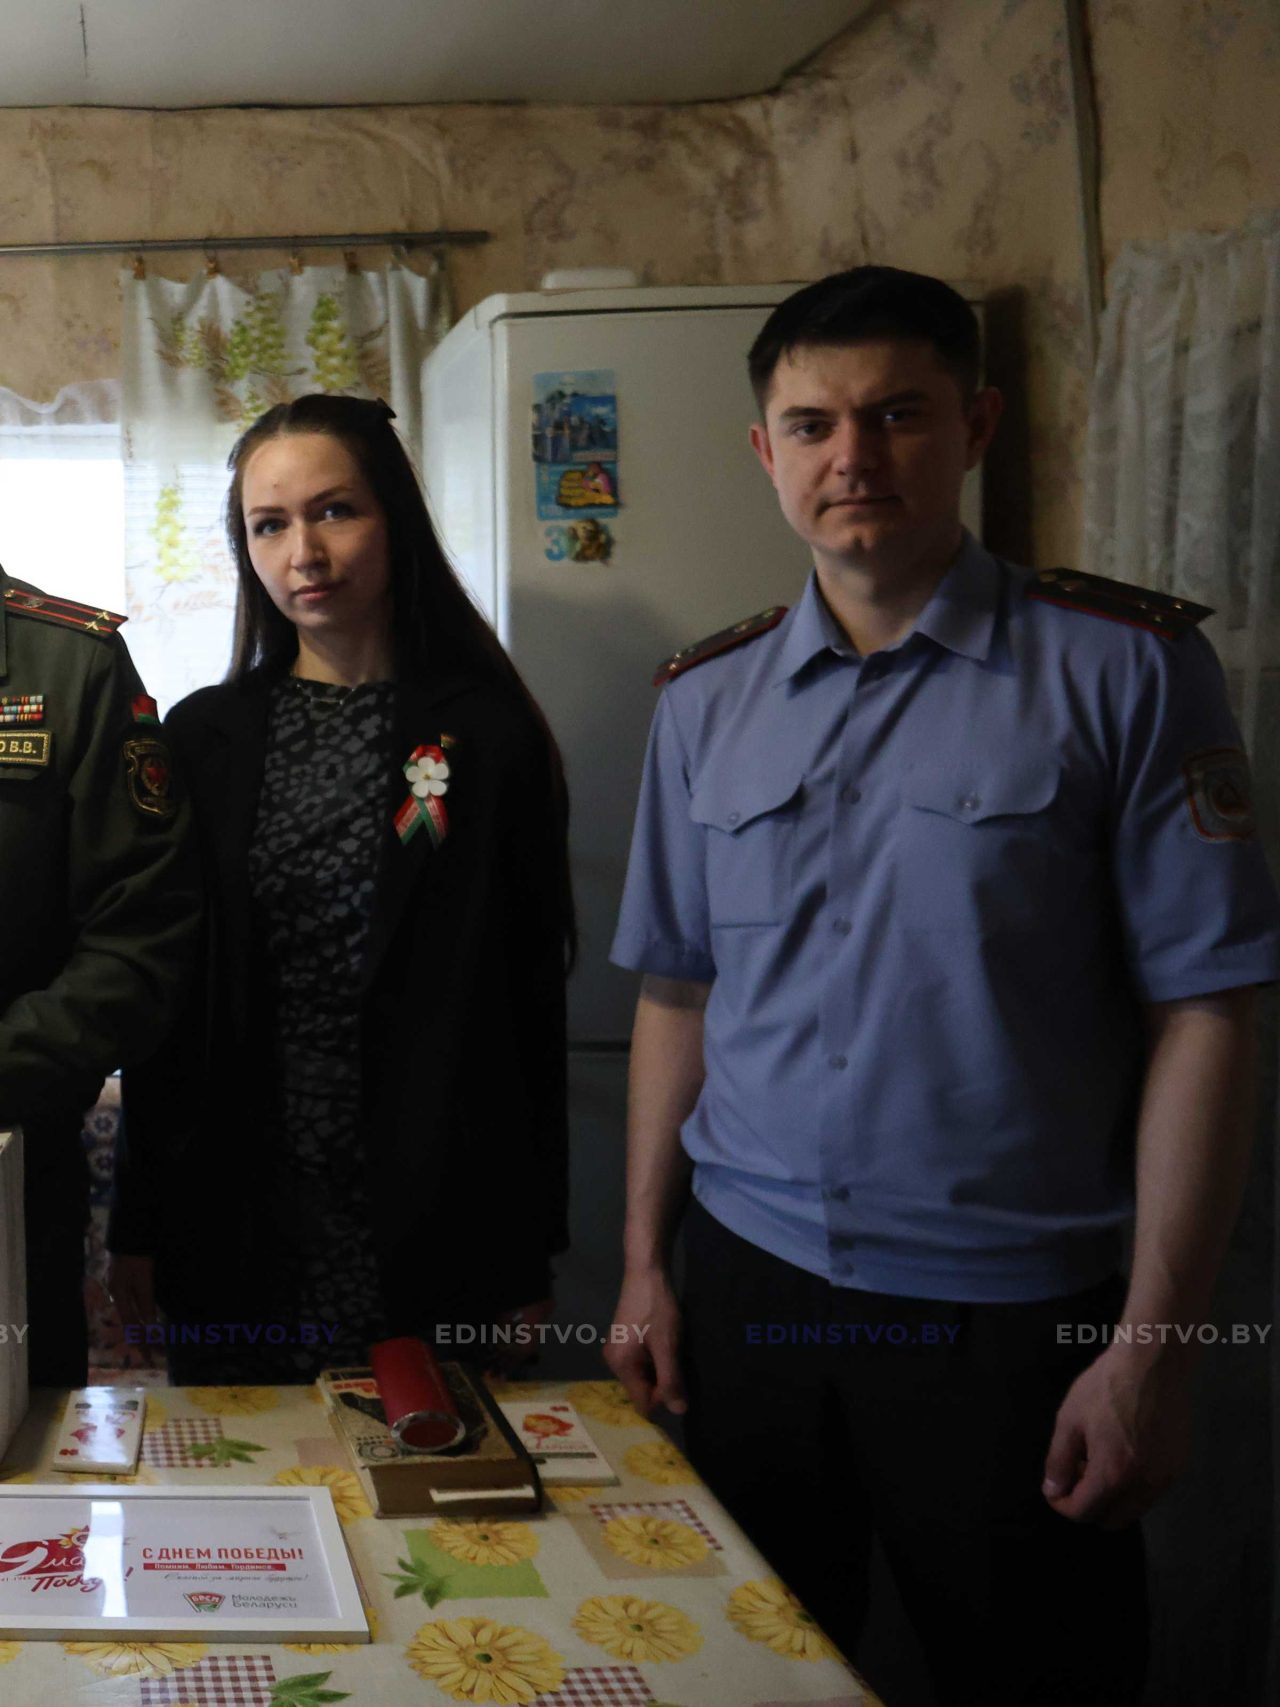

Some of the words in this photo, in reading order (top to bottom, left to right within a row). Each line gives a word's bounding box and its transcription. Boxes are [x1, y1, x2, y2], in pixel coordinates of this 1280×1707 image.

[9, 741, 37, 754] В.В.
[142, 1547, 153, 1560] С
[157, 1547, 211, 1561] ДНЕМ
[217, 1547, 305, 1561] ПОБЕДЫ!
